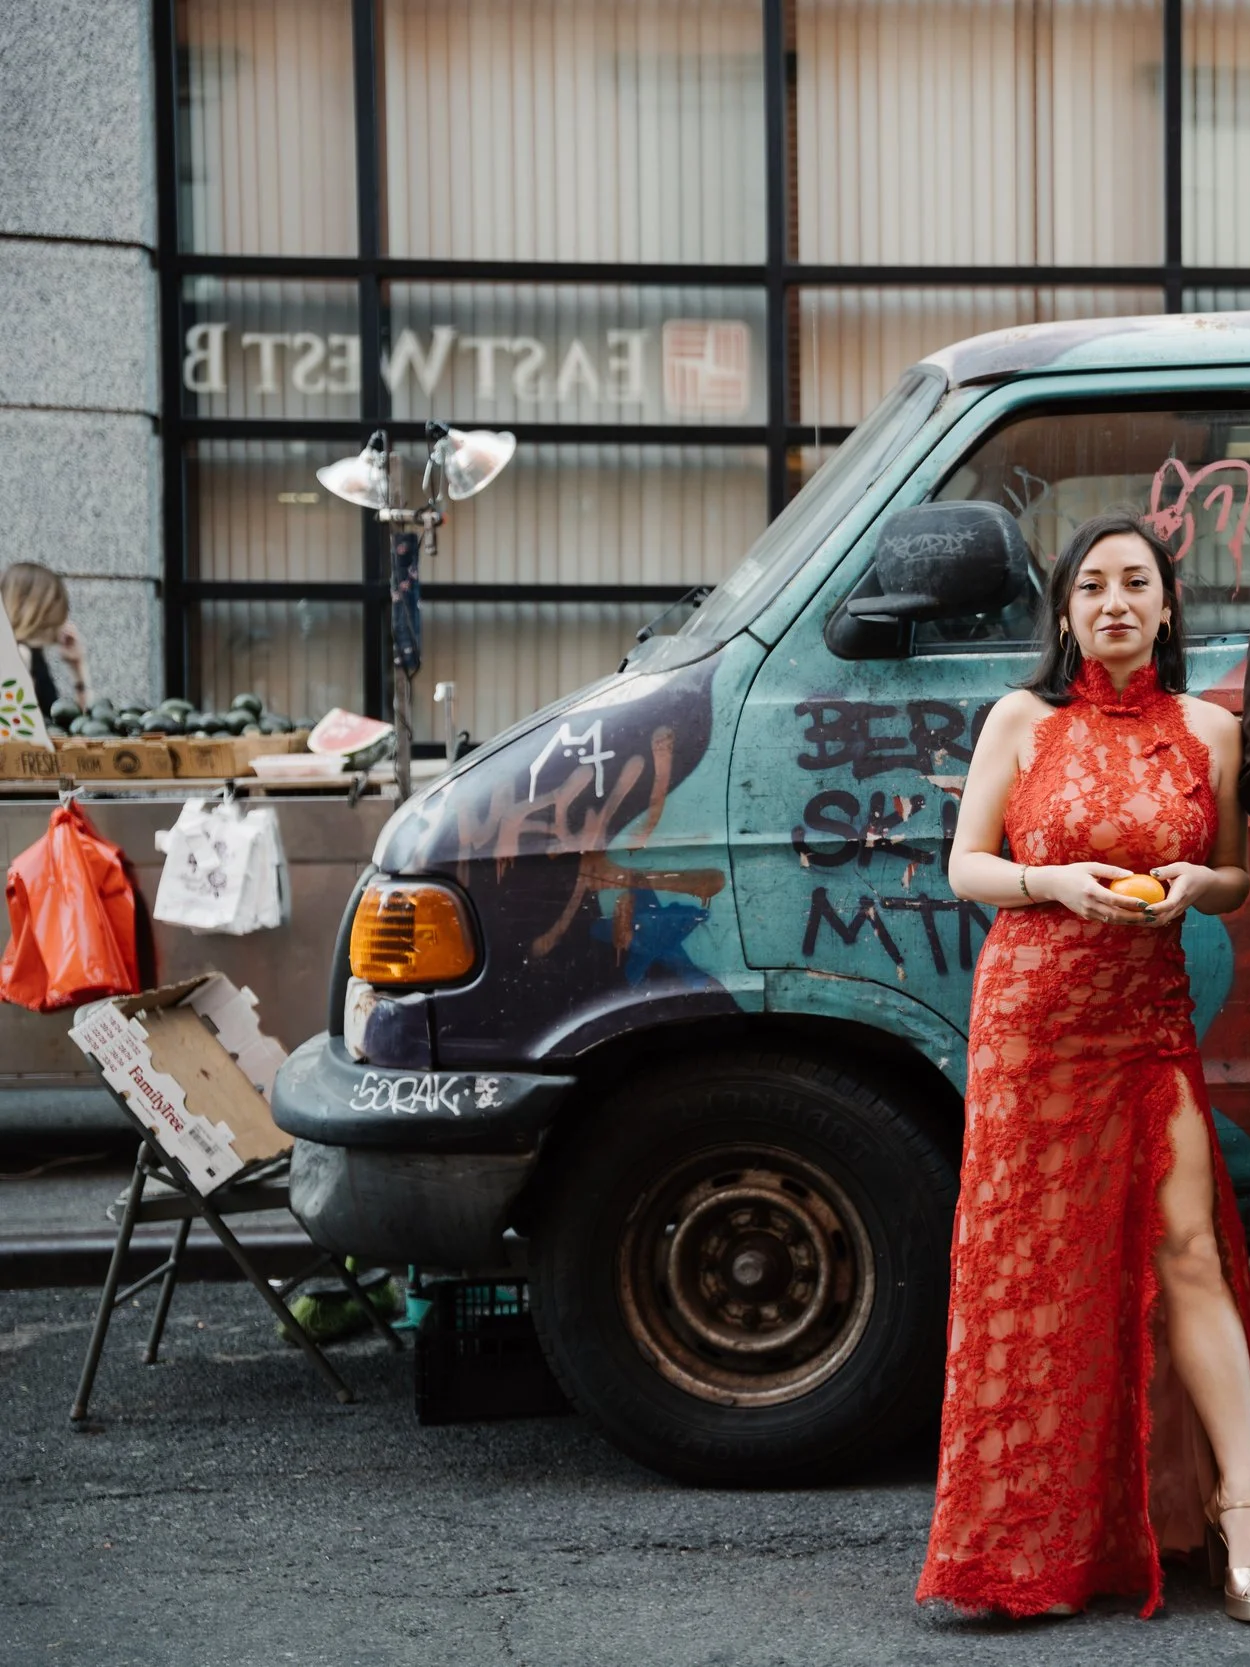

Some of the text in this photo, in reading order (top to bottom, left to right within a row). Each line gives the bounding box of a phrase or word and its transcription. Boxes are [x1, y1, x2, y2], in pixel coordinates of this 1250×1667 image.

[21, 751, 60, 775] FRESH
[76, 755, 102, 772] FROM
[128, 1065, 185, 1133] FamilyTree
